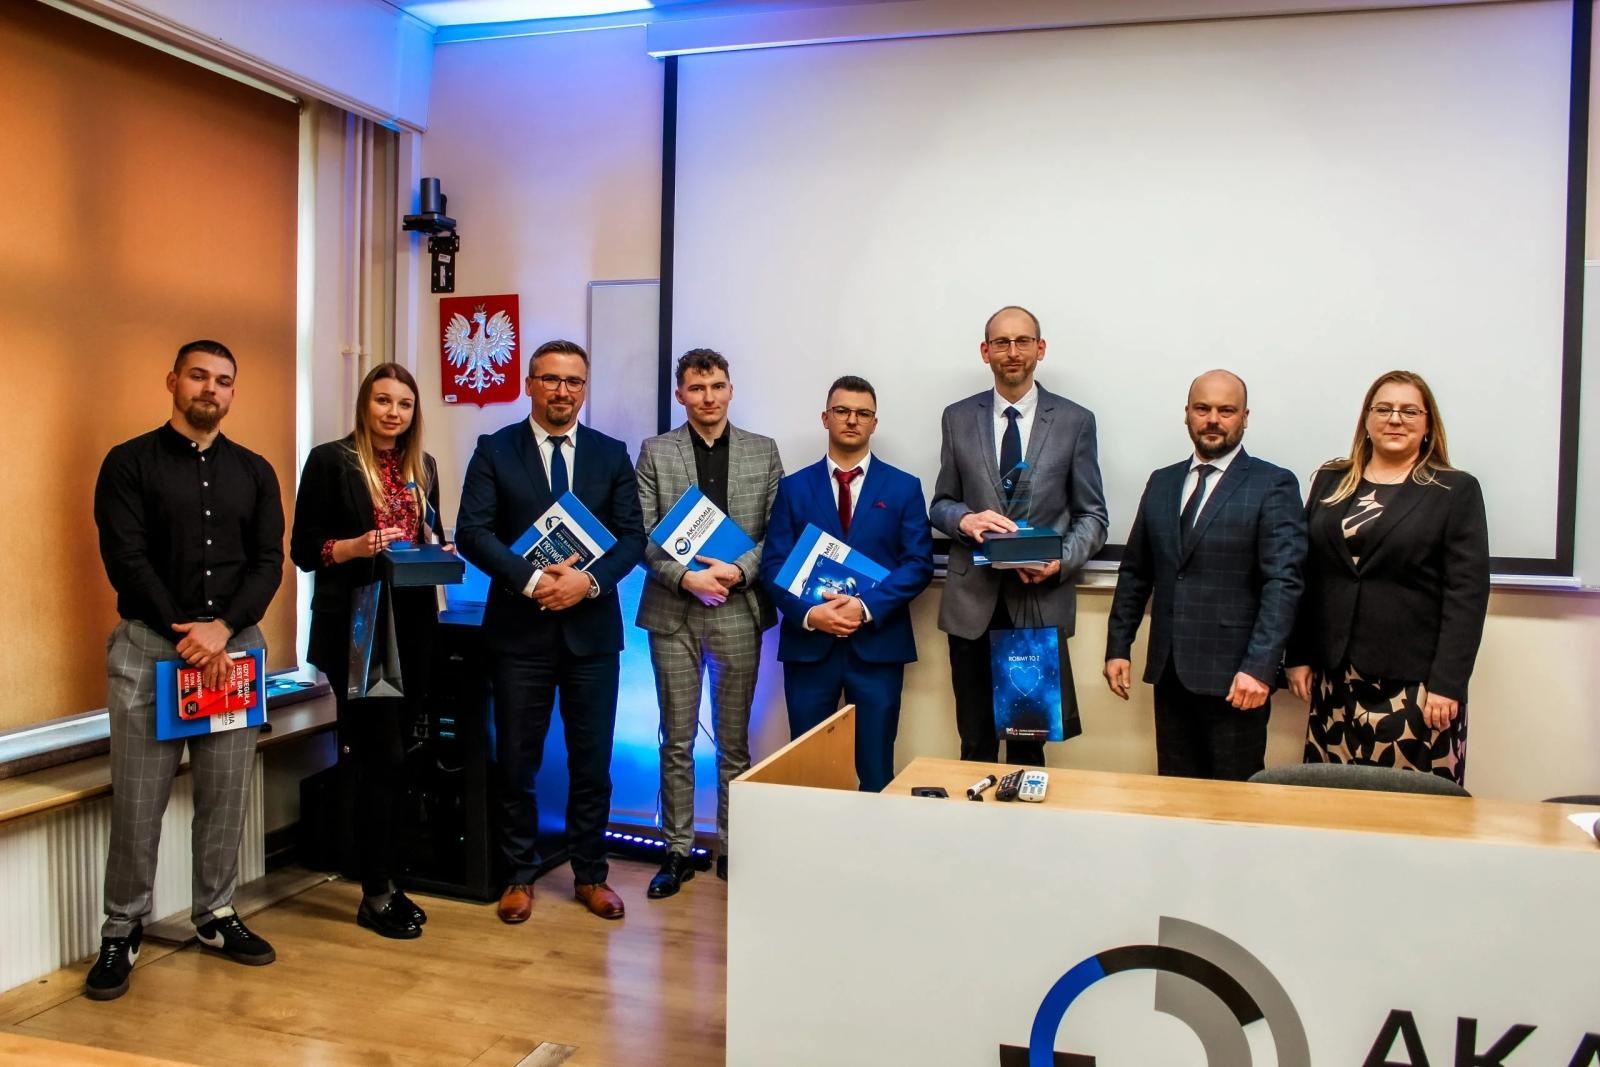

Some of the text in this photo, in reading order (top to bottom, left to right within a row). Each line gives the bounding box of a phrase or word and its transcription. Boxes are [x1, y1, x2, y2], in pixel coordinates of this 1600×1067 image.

[685, 506, 713, 536] AKADEMIA
[242, 662, 250, 678] GDY
[236, 680, 244, 698] BRAK
